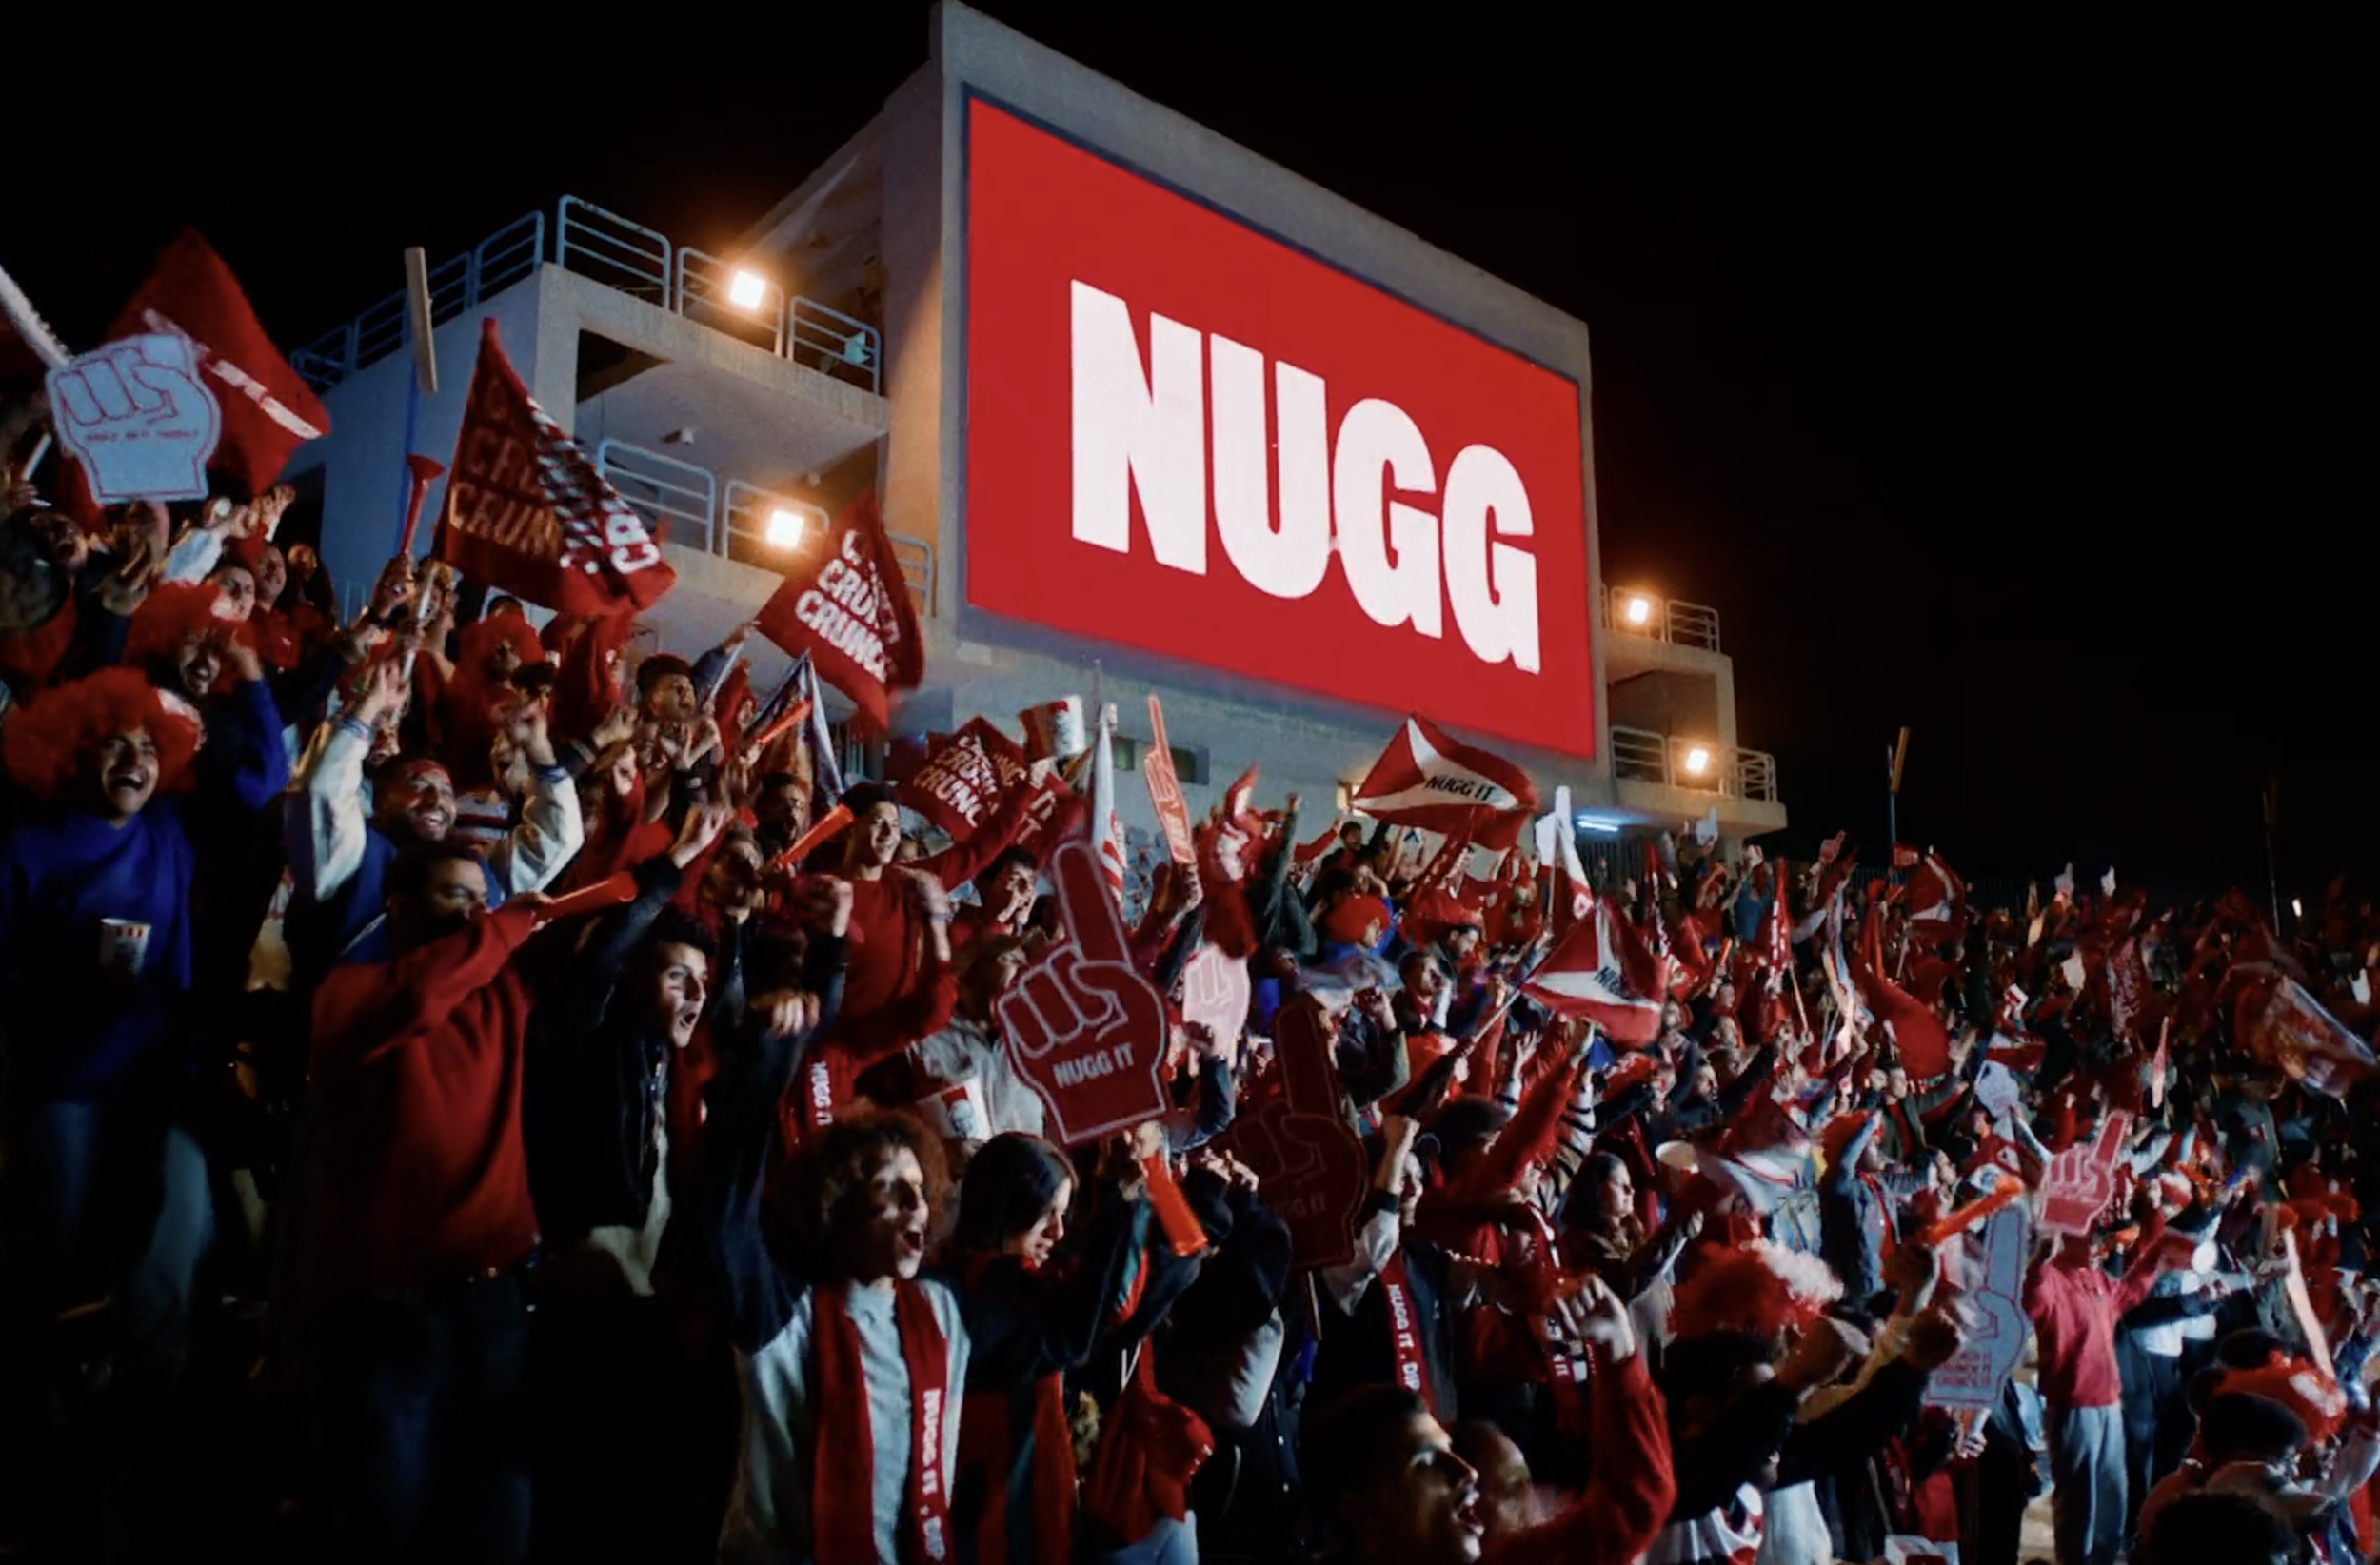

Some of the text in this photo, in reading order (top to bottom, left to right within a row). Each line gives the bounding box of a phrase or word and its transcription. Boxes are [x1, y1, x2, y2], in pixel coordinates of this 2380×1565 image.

[1071, 278, 1540, 675] NUGG
[1424, 776, 1497, 801] NUGG IT
[1052, 1042, 1134, 1089] NUGG IT
[1387, 1284, 1409, 1330] NUGG
[1398, 1333, 1415, 1348] IT
[922, 1387, 942, 1468] NUGG
